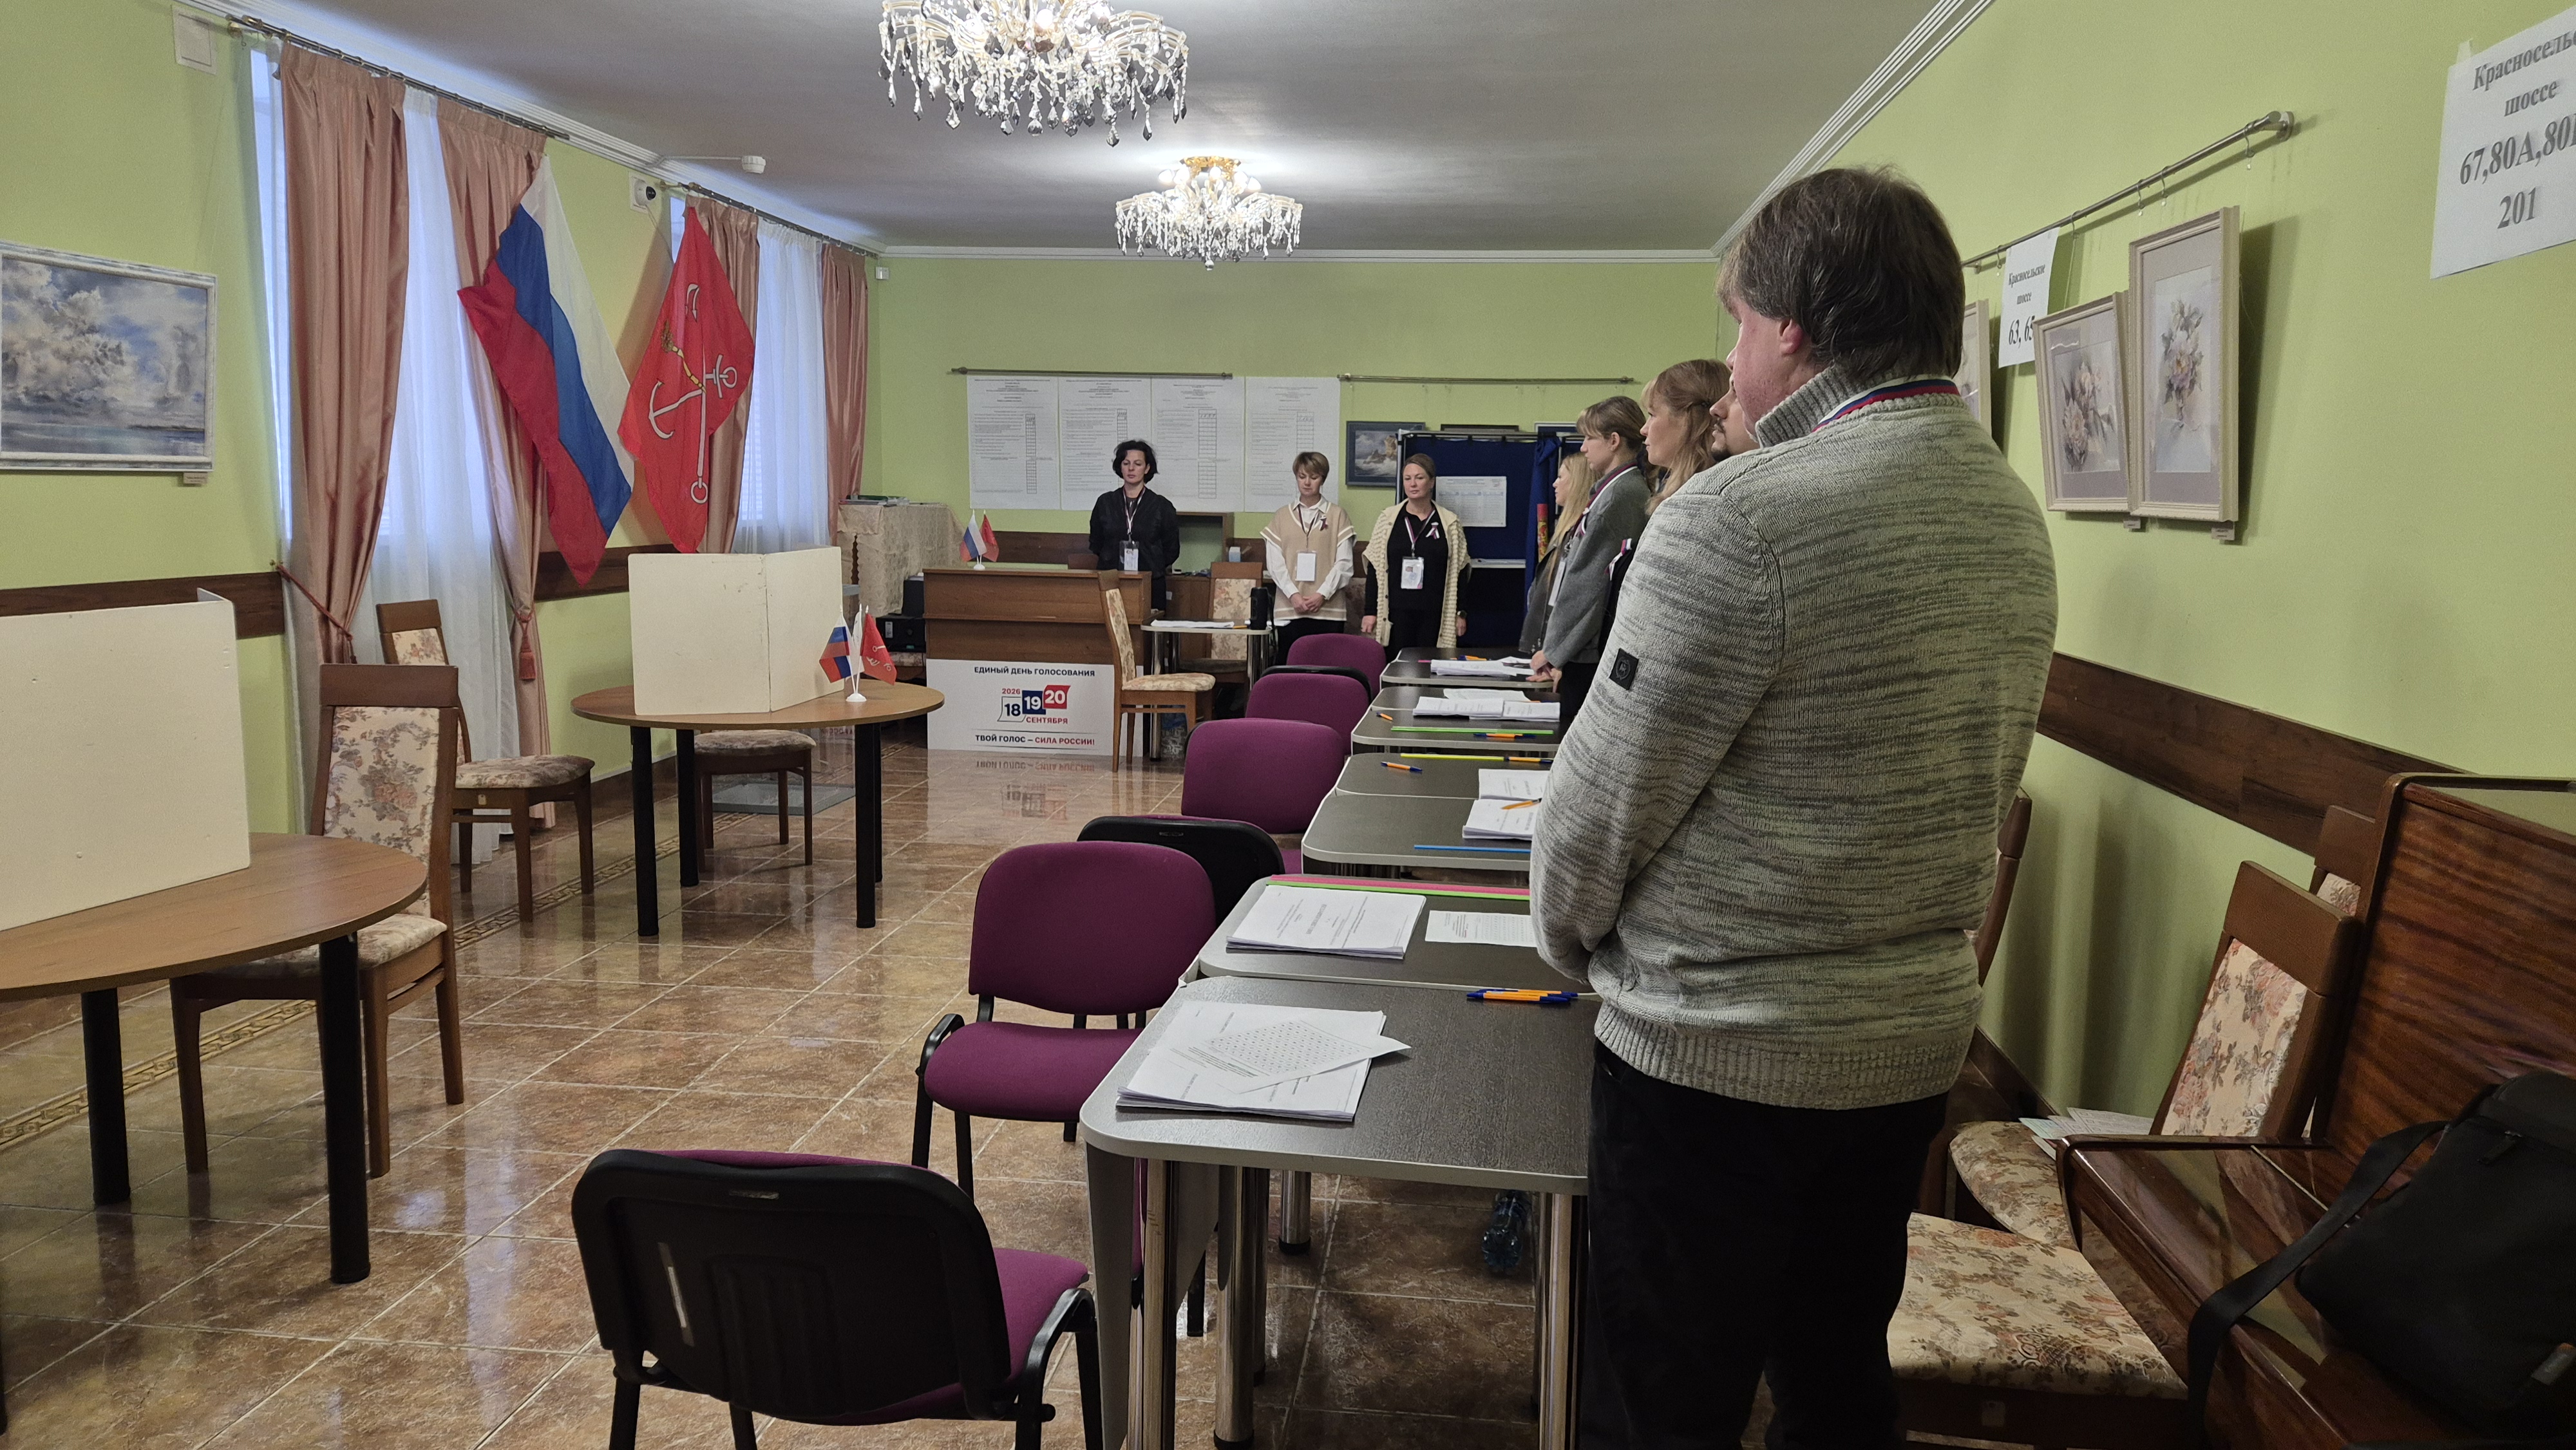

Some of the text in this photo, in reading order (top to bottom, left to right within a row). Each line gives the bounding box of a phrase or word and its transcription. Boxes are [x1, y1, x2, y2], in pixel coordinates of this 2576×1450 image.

[2504, 80, 2559, 117] шоссе
[2497, 187, 2536, 229] 201
[2016, 292, 2032, 305] шоссе
[2009, 319, 2021, 348] 63,
[1034, 668, 1095, 677] ГОЛОСОВАНИЯ
[1004, 690, 1066, 717] 18 19 20
